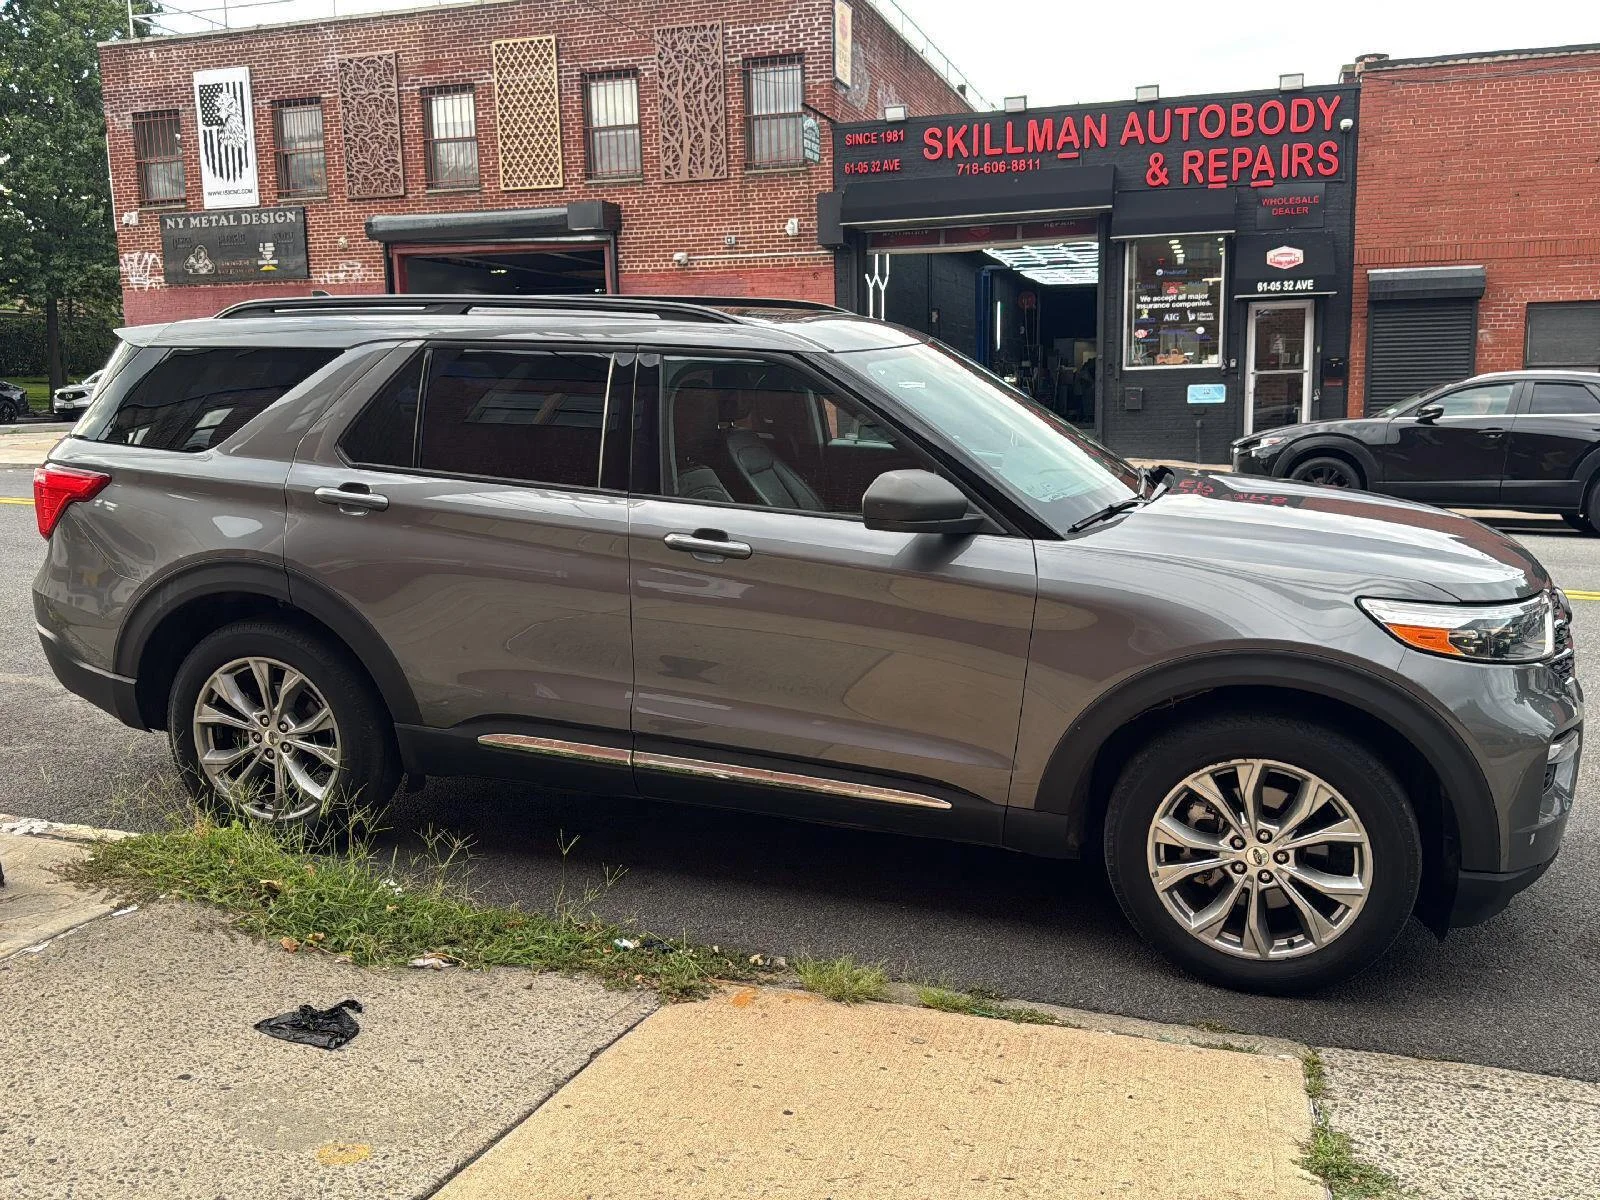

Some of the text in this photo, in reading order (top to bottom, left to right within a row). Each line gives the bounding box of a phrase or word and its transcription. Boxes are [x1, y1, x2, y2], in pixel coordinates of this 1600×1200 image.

[923, 96, 1341, 161] SKILLMAN AUTOBODY
[845, 129, 904, 146] SINCE 1981
[844, 158, 901, 174] 61-05 32 AVE
[957, 158, 1040, 175] 718-606-8811
[1145, 140, 1339, 187] & REPAIRS
[1262, 195, 1319, 206] WHOLESALE
[1272, 206, 1309, 216] DEALER
[166, 211, 297, 230] NY METAL DESIGN
[1257, 279, 1314, 292] 61-05 32 AVE
[1140, 293, 1209, 303] We accept all major
[1163, 313, 1180, 321] AIG
